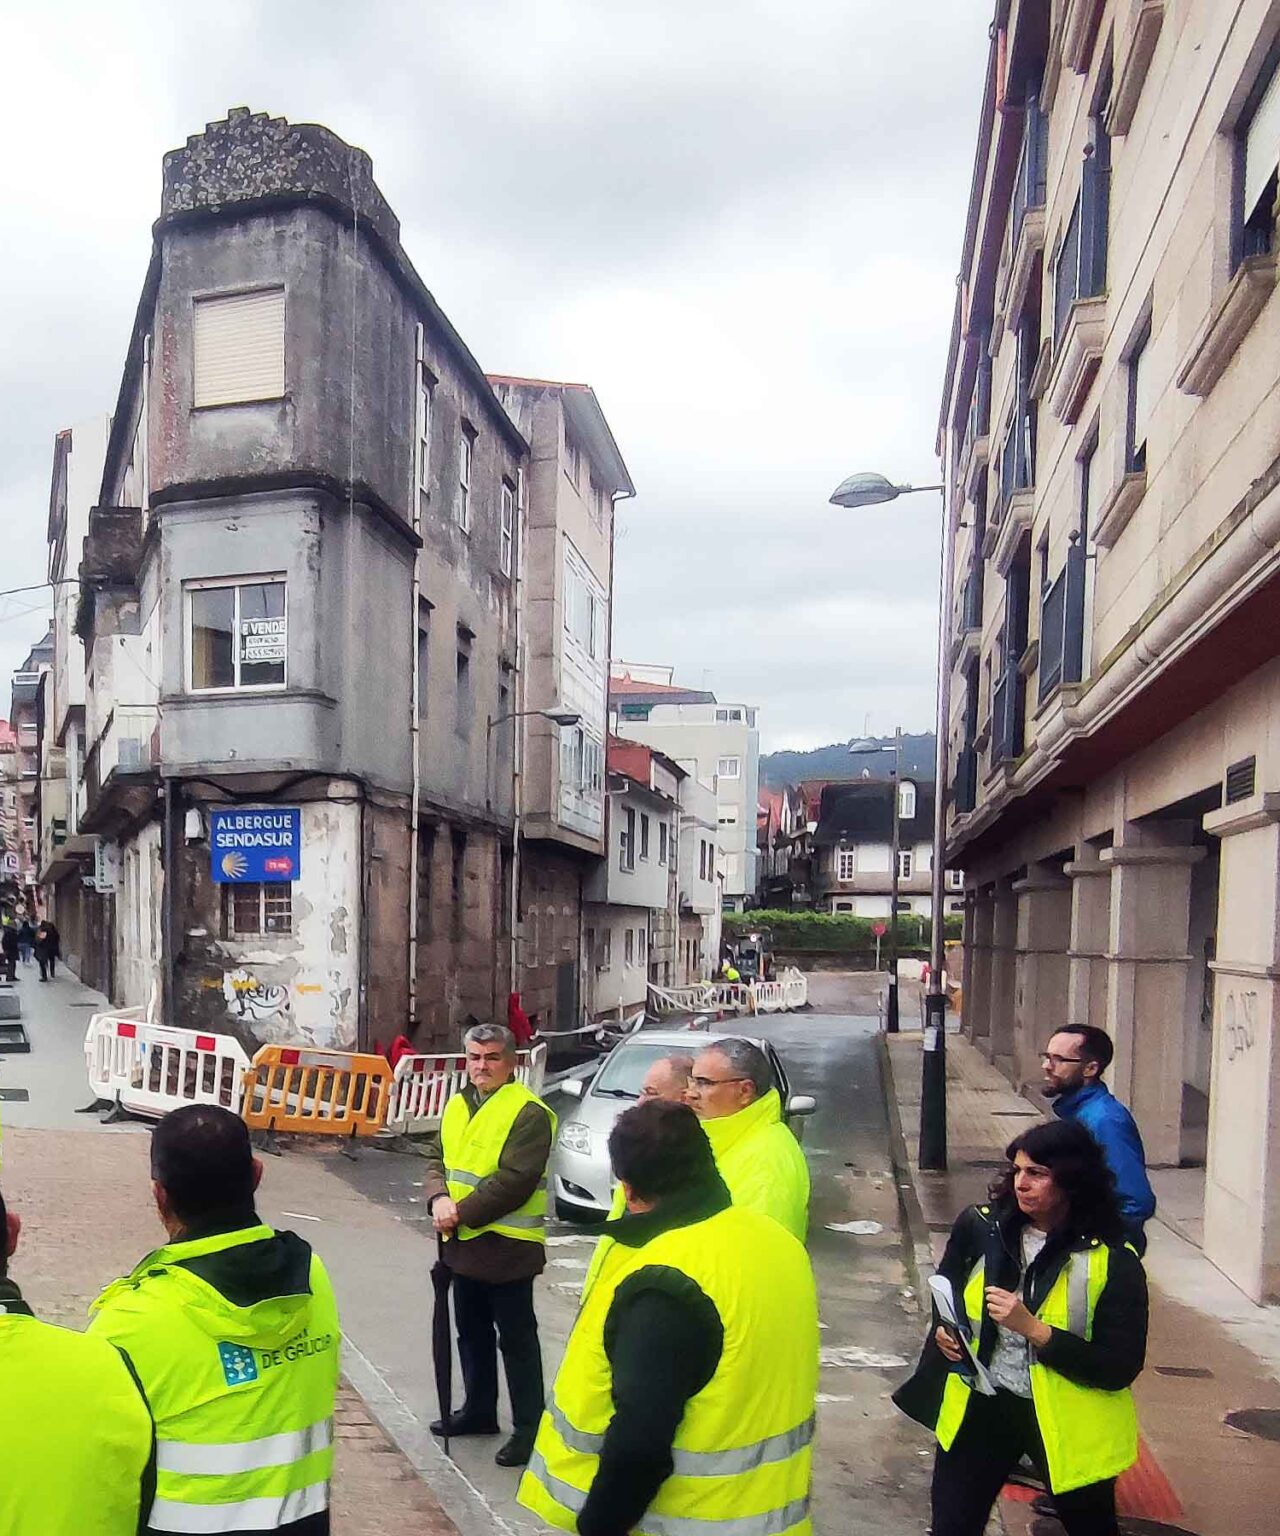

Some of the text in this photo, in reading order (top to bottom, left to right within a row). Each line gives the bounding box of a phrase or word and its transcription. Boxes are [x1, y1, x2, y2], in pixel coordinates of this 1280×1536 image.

[250, 620, 285, 635] VENDE
[217, 815, 292, 830] ALBERGUE
[216, 832, 293, 848] SENDASUR
[262, 1350, 283, 1369] DE
